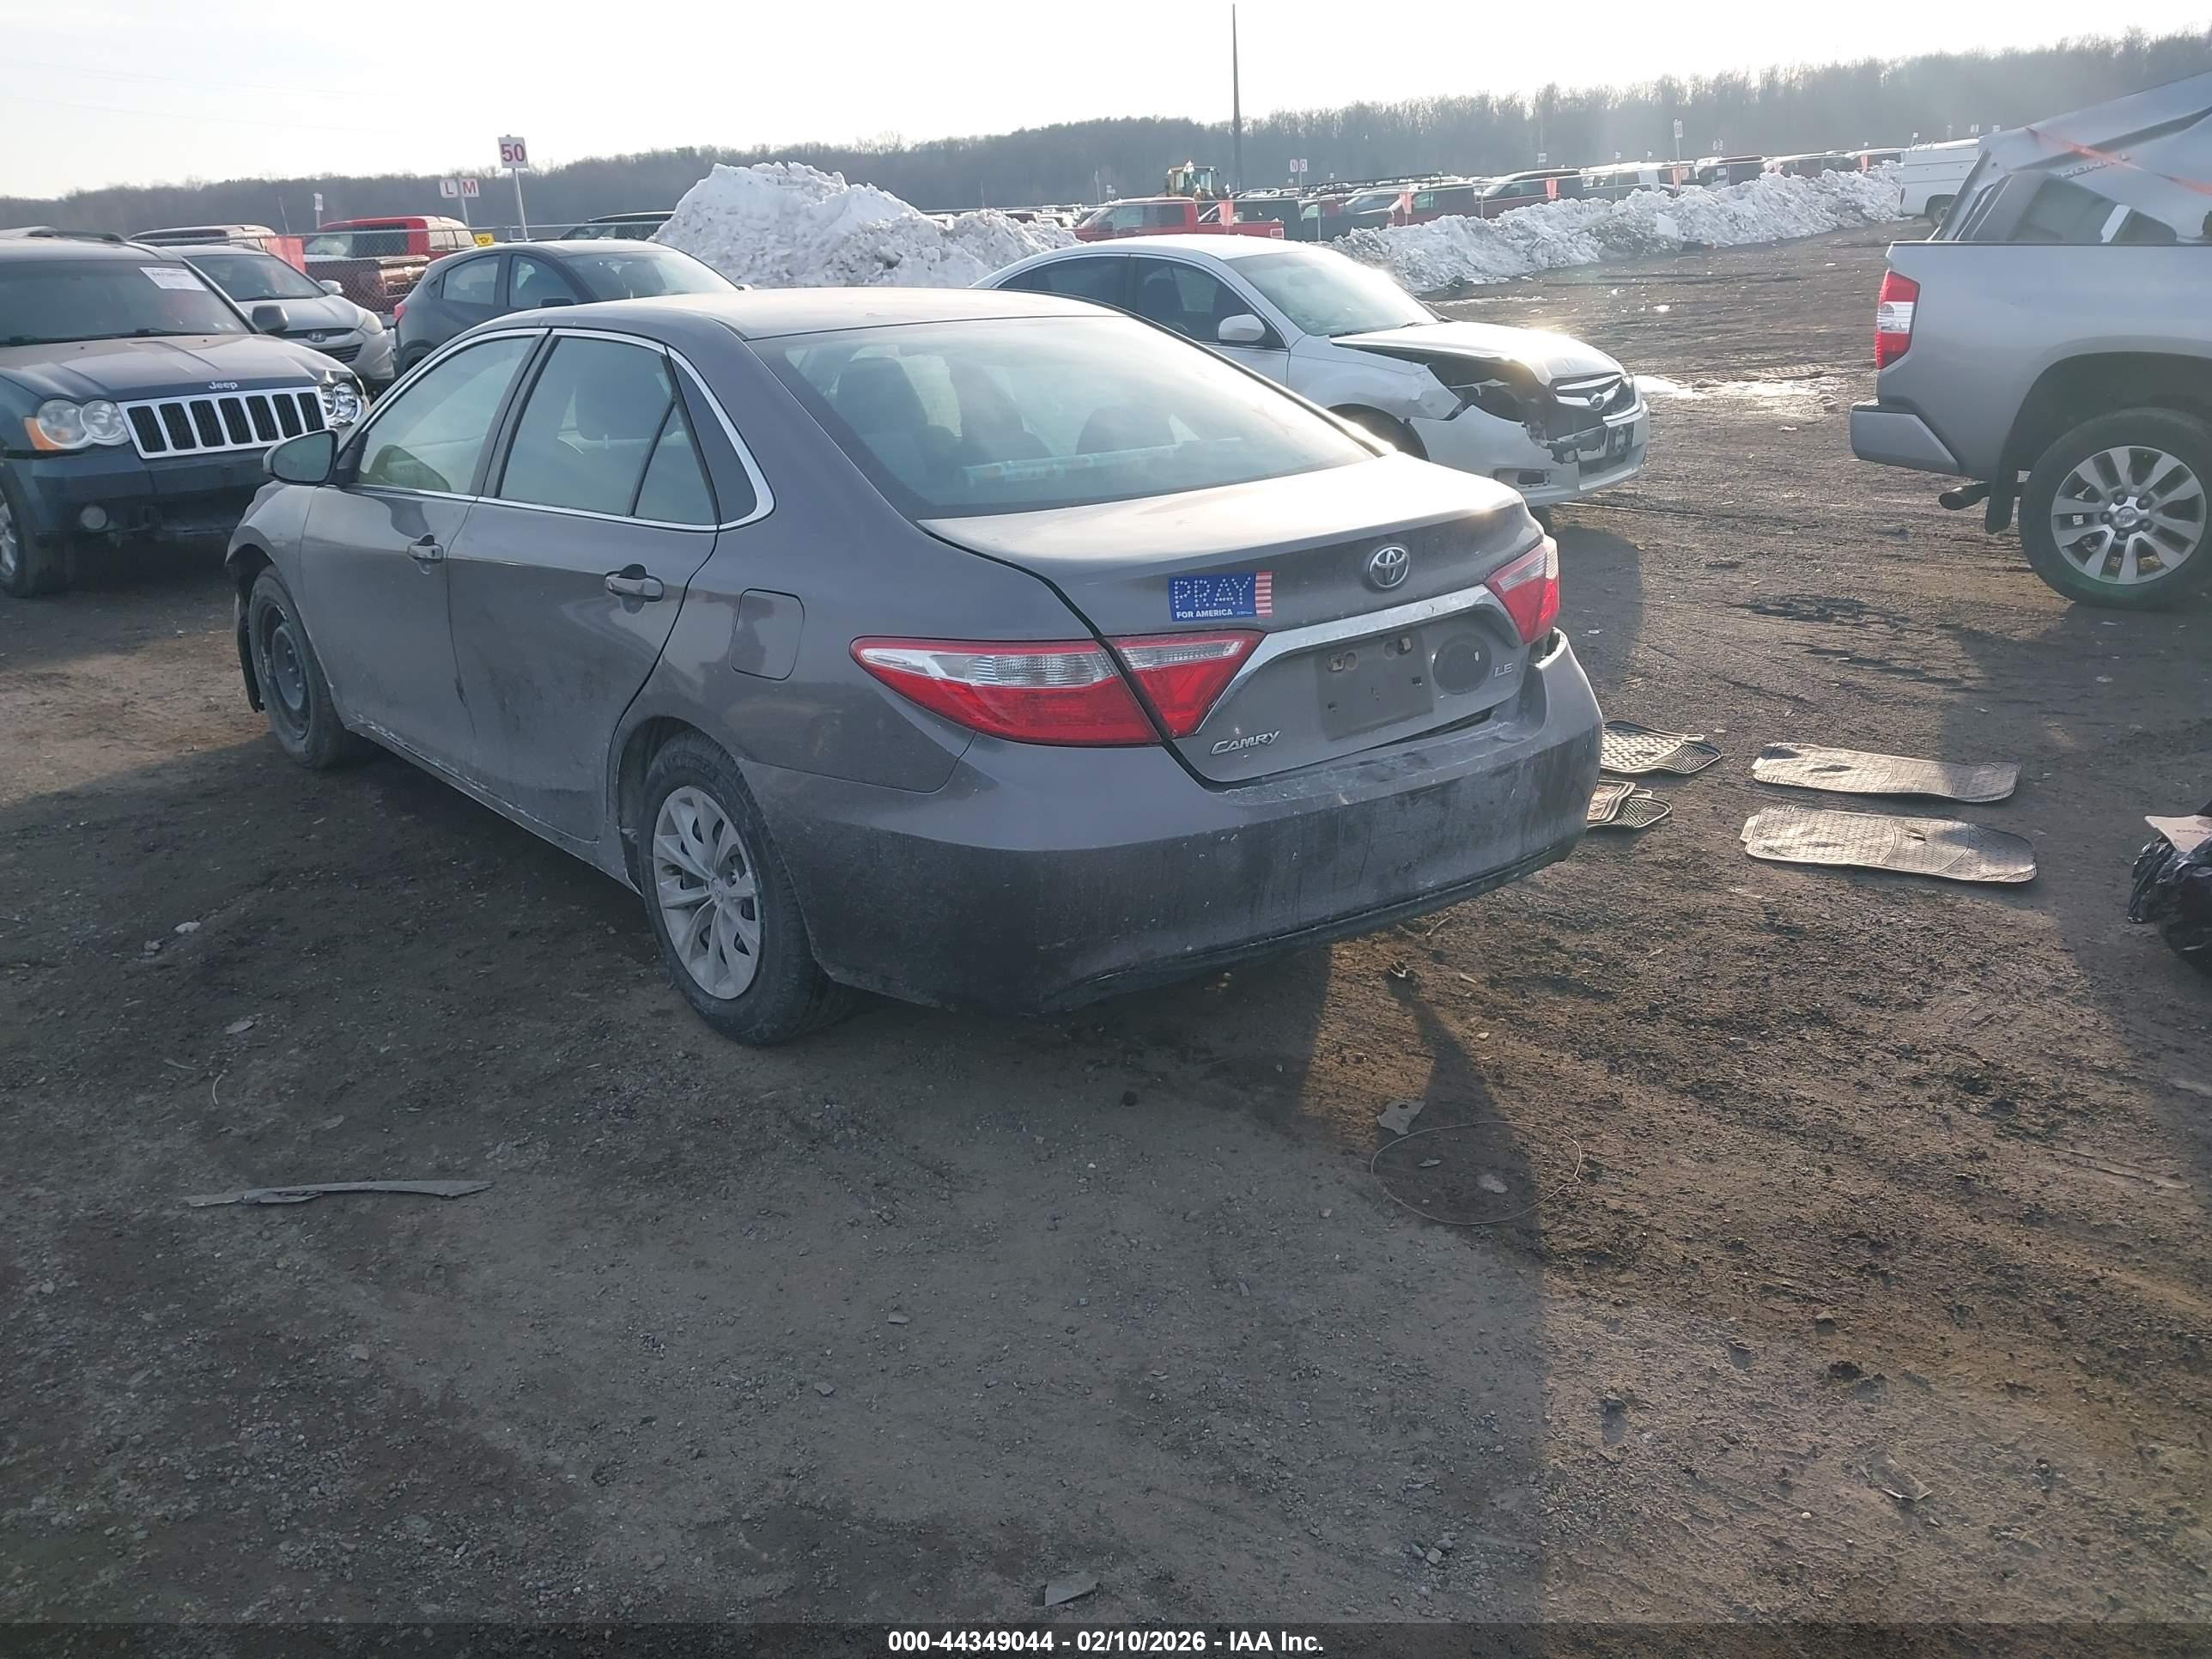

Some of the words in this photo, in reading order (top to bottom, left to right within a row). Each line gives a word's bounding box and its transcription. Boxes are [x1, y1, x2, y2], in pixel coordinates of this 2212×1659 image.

[501, 143, 525, 162] 50
[445, 182, 454, 195] L
[462, 181, 477, 194] M
[208, 381, 239, 390] Jeep
[1174, 576, 1251, 609] PRAY
[1176, 611, 1194, 619] FOR
[1194, 609, 1233, 617] AMERICA
[1494, 662, 1514, 678] LE
[1211, 730, 1280, 755] CAMRY
